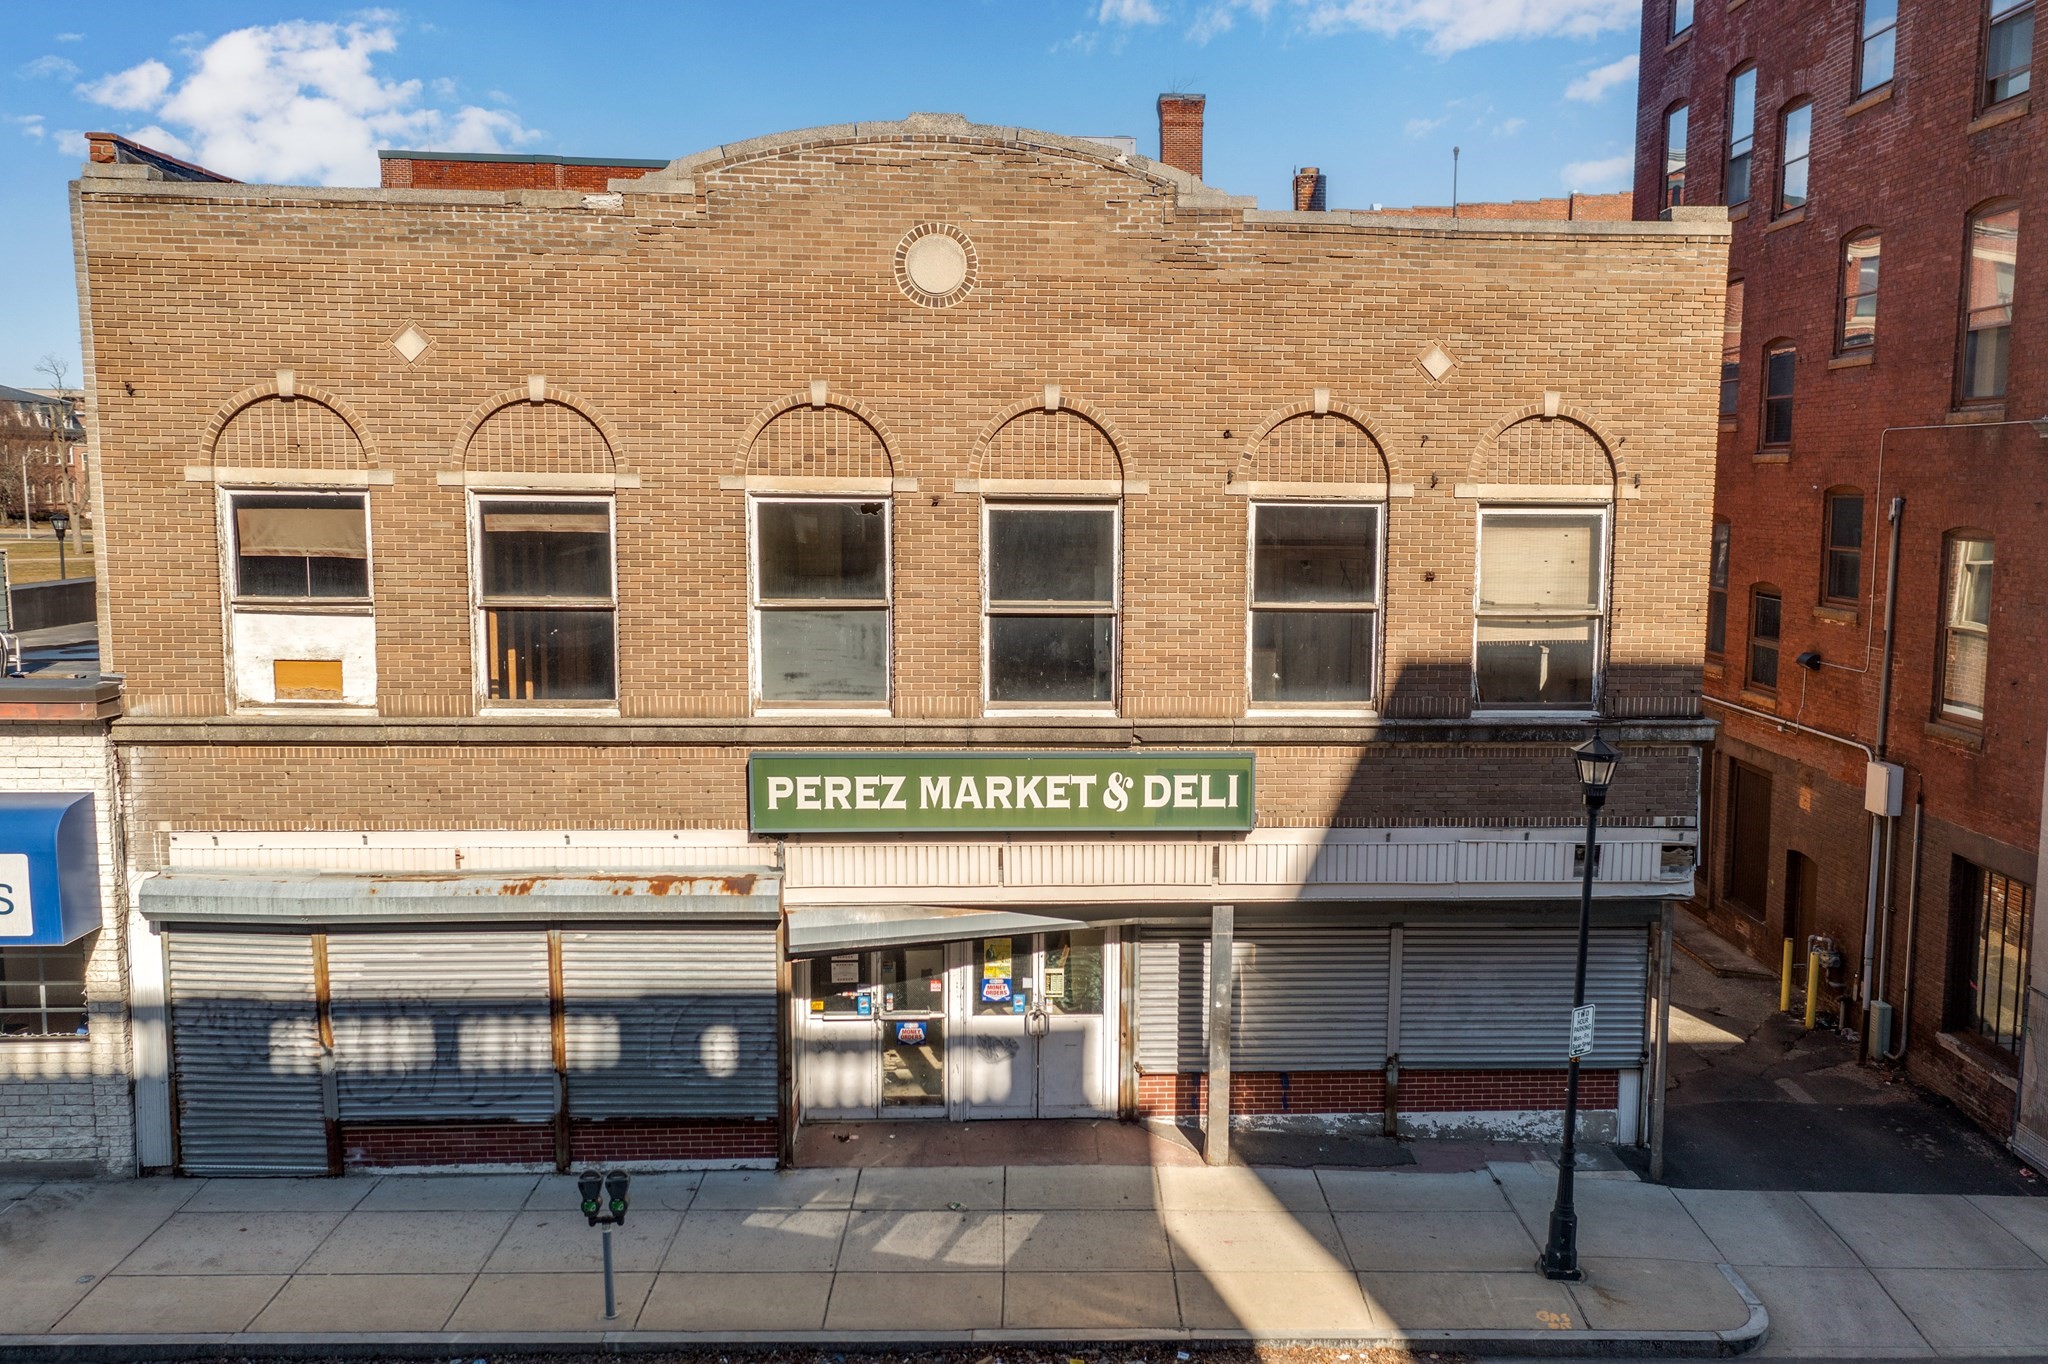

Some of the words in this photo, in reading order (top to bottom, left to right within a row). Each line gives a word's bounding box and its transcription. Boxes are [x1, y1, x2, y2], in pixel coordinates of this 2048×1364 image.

[767, 775, 906, 810] PEREZ
[919, 774, 1097, 809] MARKET
[1103, 772, 1134, 812] &
[1143, 774, 1239, 809] DELI
[1577, 1010, 1589, 1019] TWO
[1576, 1017, 1589, 1025] HOUR
[1574, 1024, 1591, 1033] PARKING
